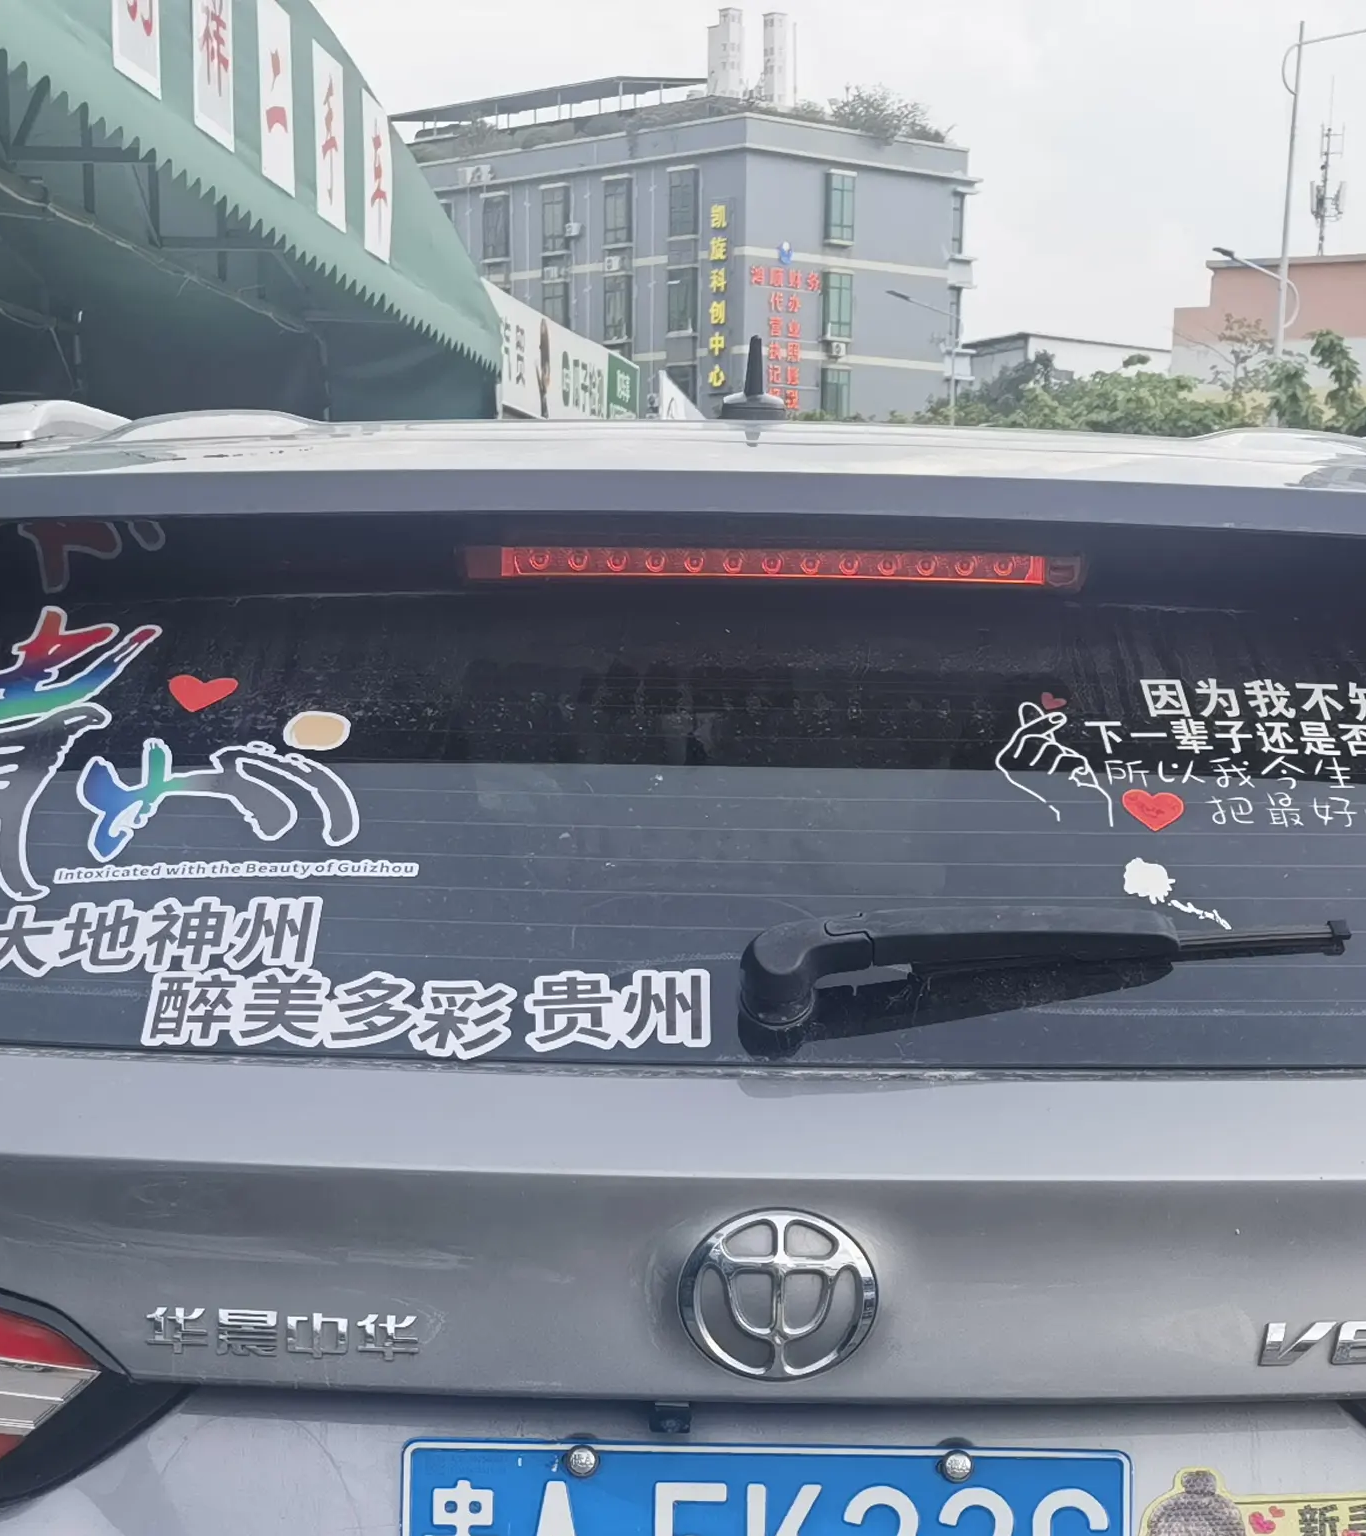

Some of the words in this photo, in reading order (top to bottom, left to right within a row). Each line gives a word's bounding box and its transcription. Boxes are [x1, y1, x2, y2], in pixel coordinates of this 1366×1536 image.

[708, 204, 728, 388] 凯旋科创中心
[750, 265, 822, 292] 鸿顺财务
[57, 865, 161, 881] Intoxicated
[166, 863, 206, 876] with
[211, 862, 241, 875] the
[246, 862, 310, 877] Beauty
[315, 861, 335, 874] of
[338, 861, 415, 875] Guizhou
[148, 972, 708, 1057] 醉美多彩贵州
[145, 1307, 421, 1362] 华晨中华
